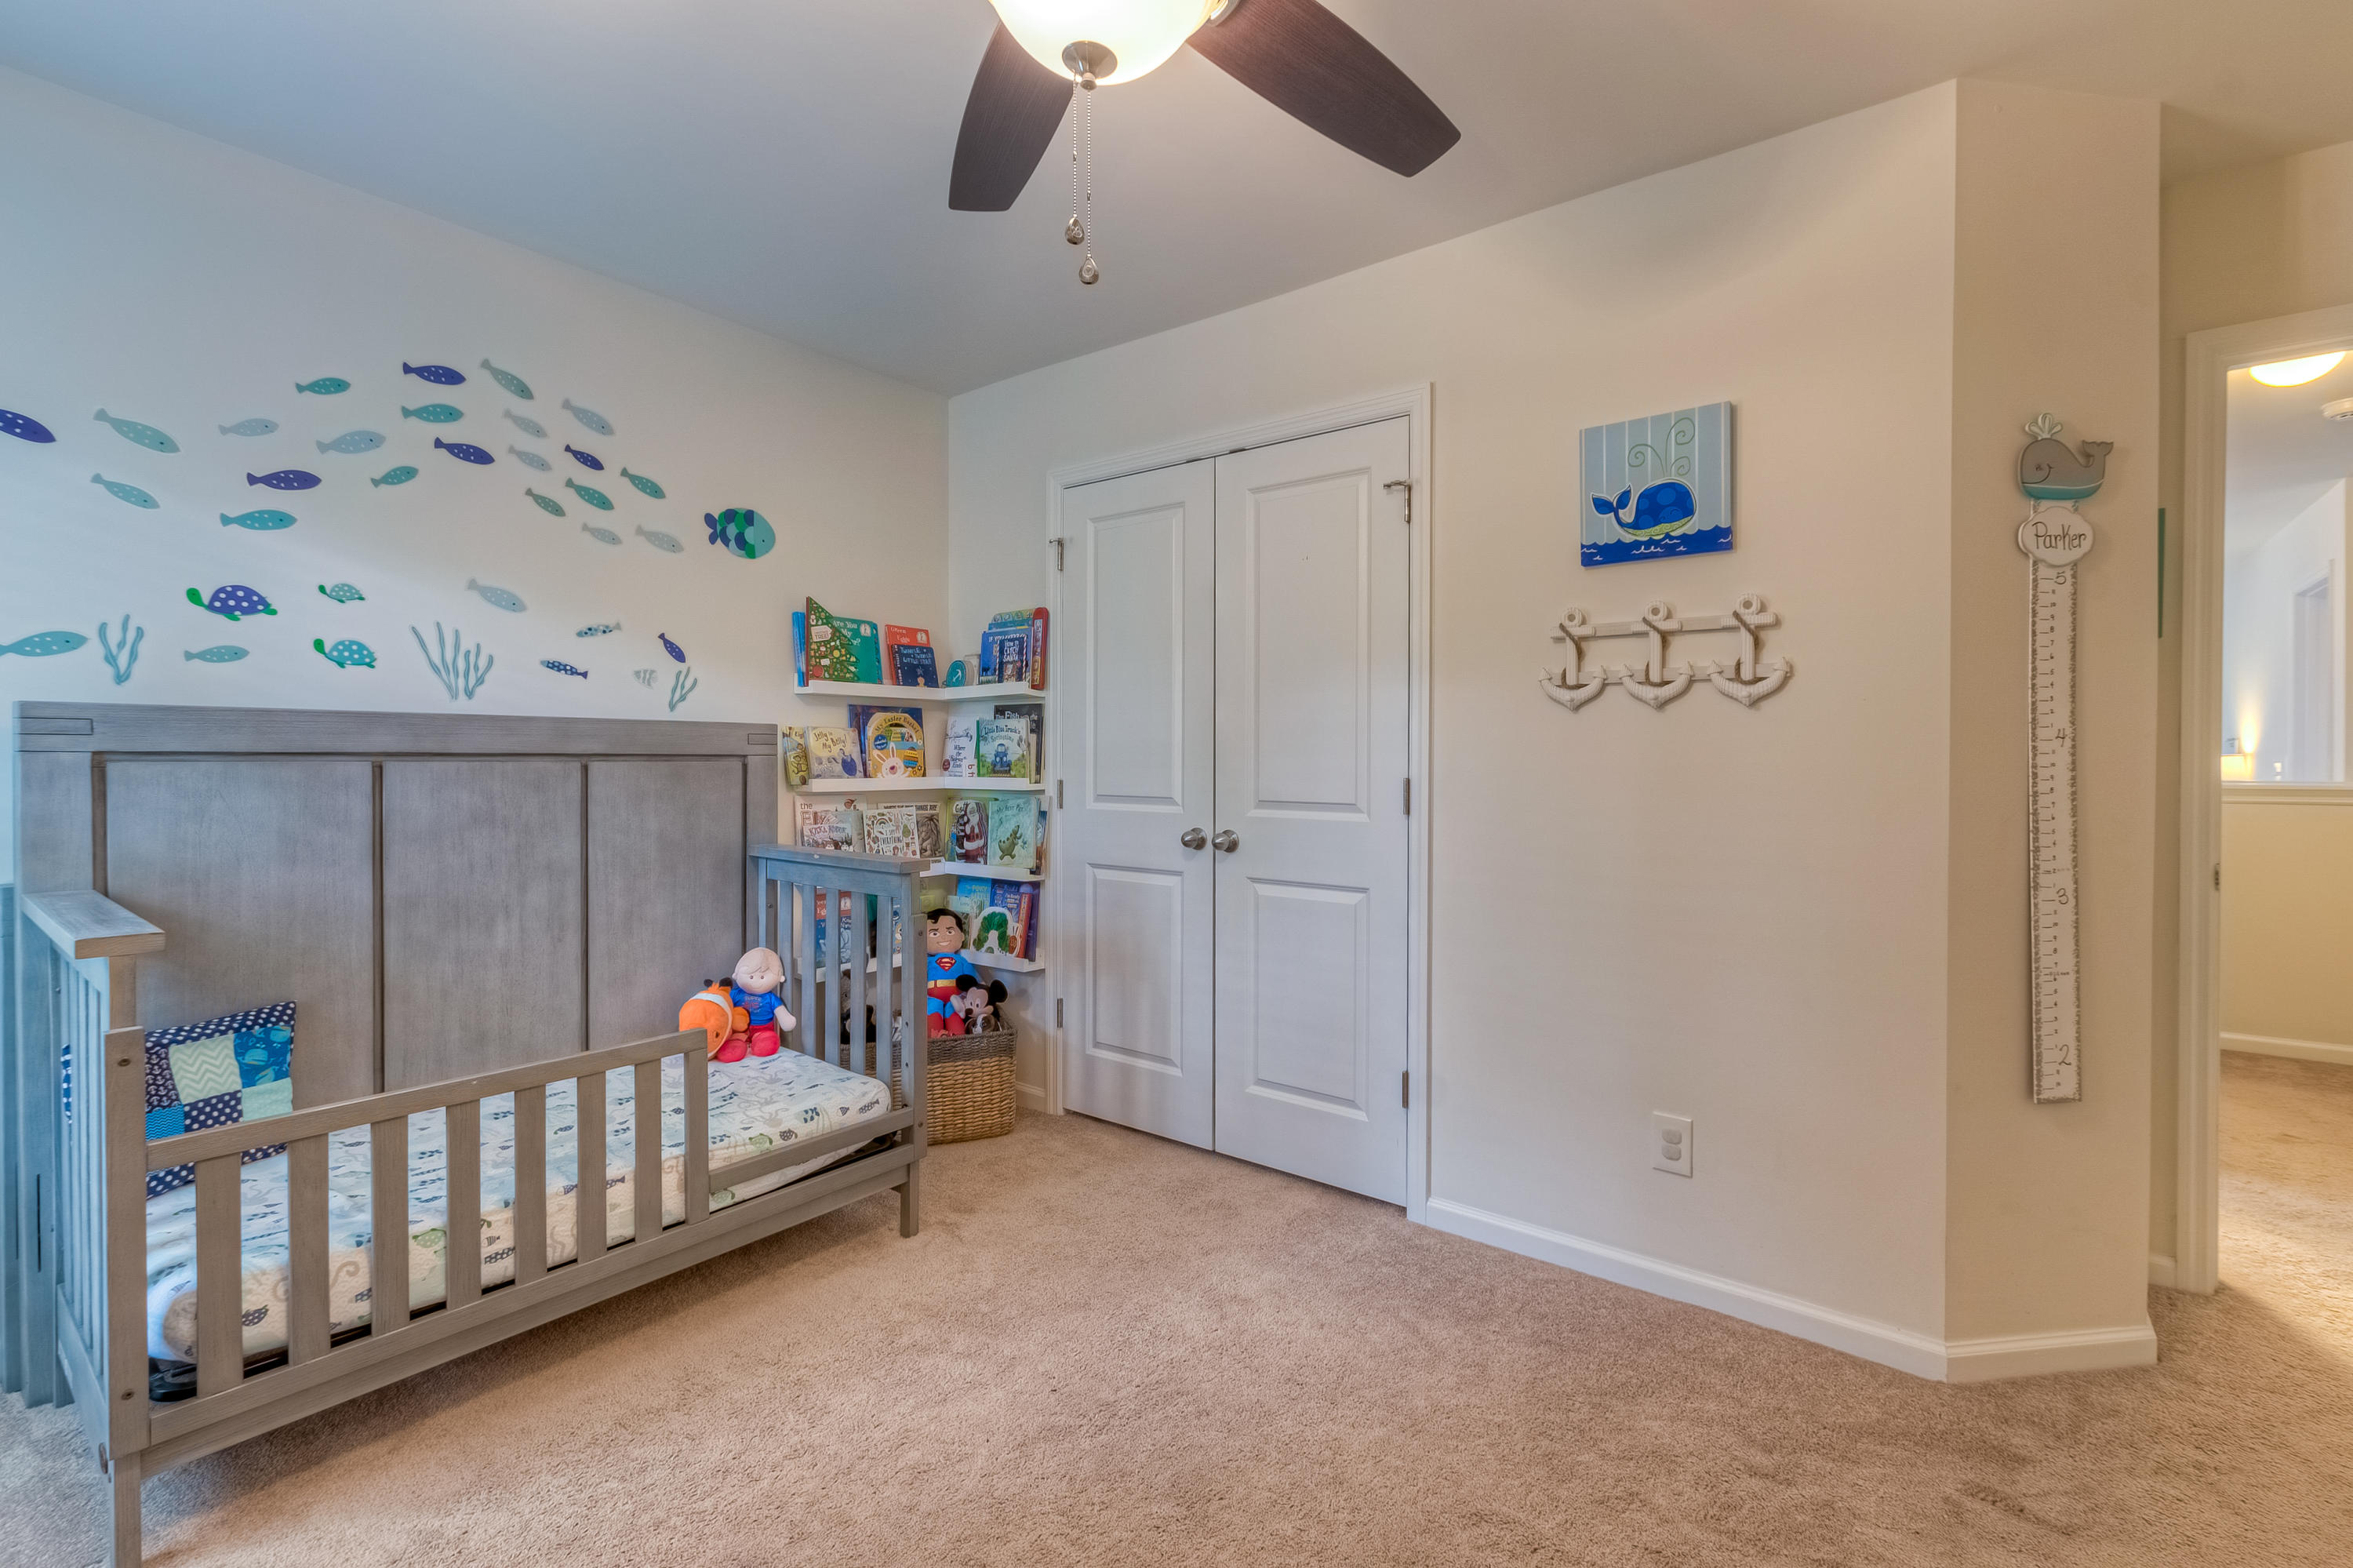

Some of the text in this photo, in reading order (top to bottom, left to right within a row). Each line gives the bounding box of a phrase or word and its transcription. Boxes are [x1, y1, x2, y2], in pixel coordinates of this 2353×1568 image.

[2031, 521, 2087, 551] Parker
[2053, 571, 2067, 585] 5
[2055, 728, 2068, 747] 4
[2056, 888, 2069, 904] 3
[2058, 1044, 2071, 1066] 2
